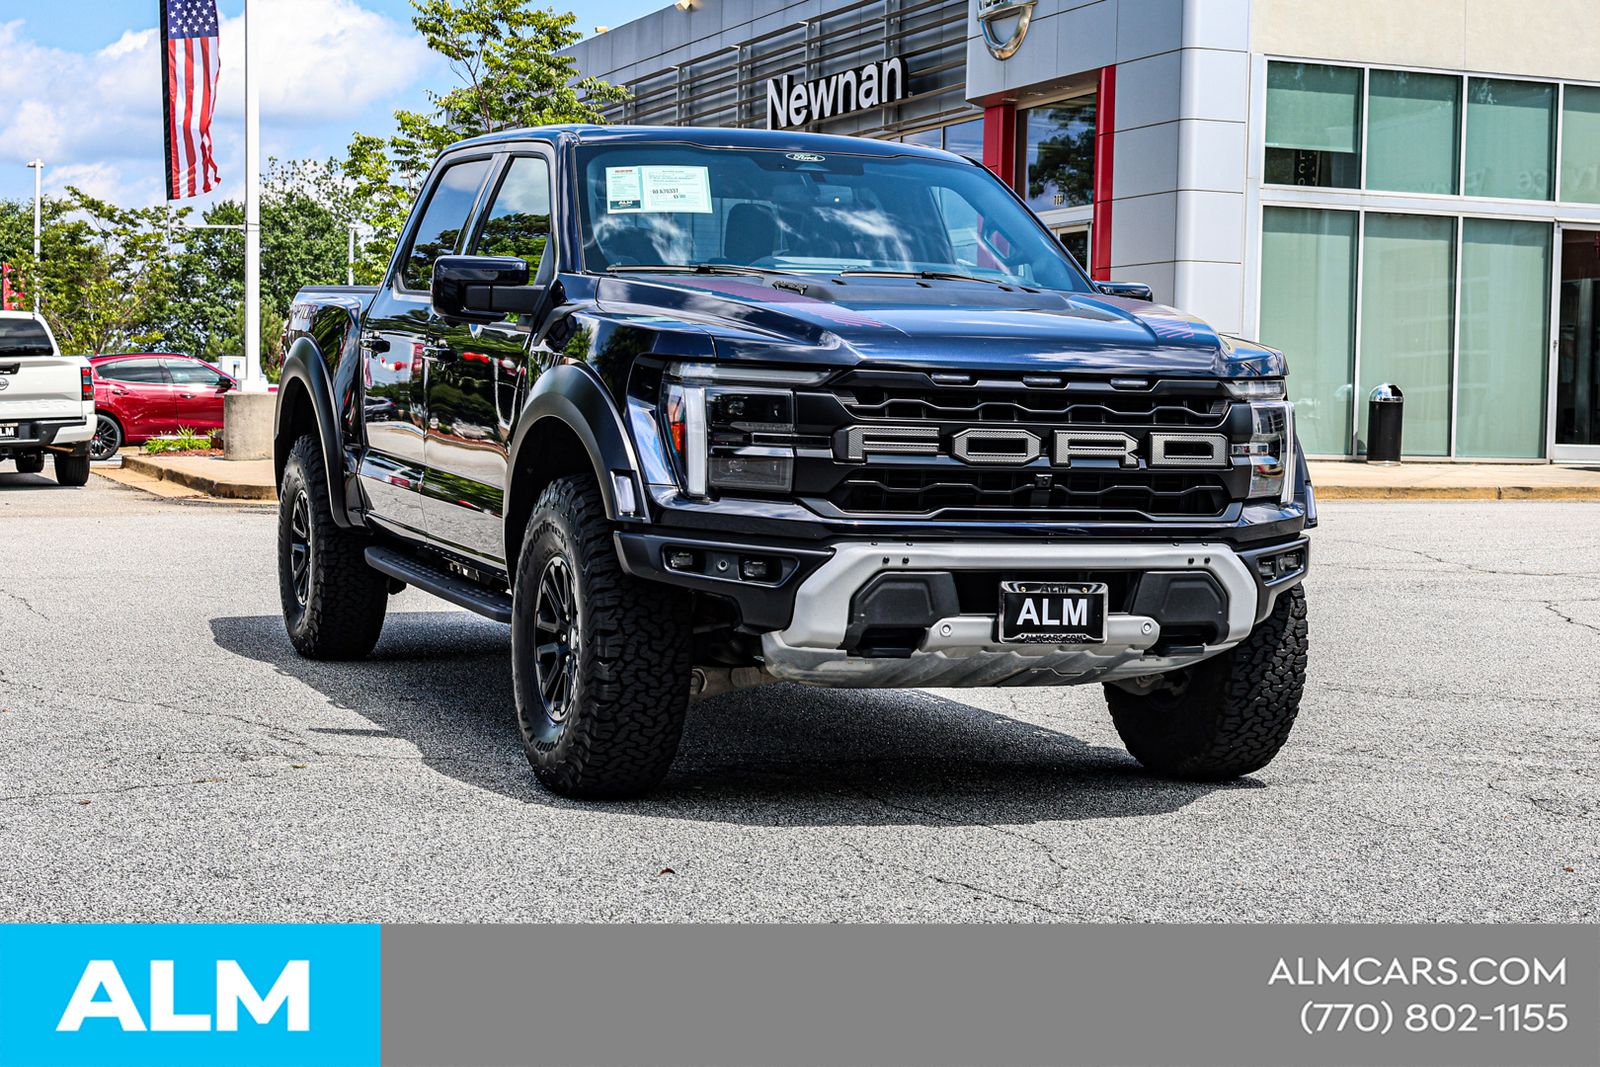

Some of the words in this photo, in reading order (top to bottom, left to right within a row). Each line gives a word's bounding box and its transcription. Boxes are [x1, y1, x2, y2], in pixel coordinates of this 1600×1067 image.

[767, 57, 904, 130] Newnan
[835, 425, 1229, 469] FORD
[1016, 597, 1088, 626] ALM
